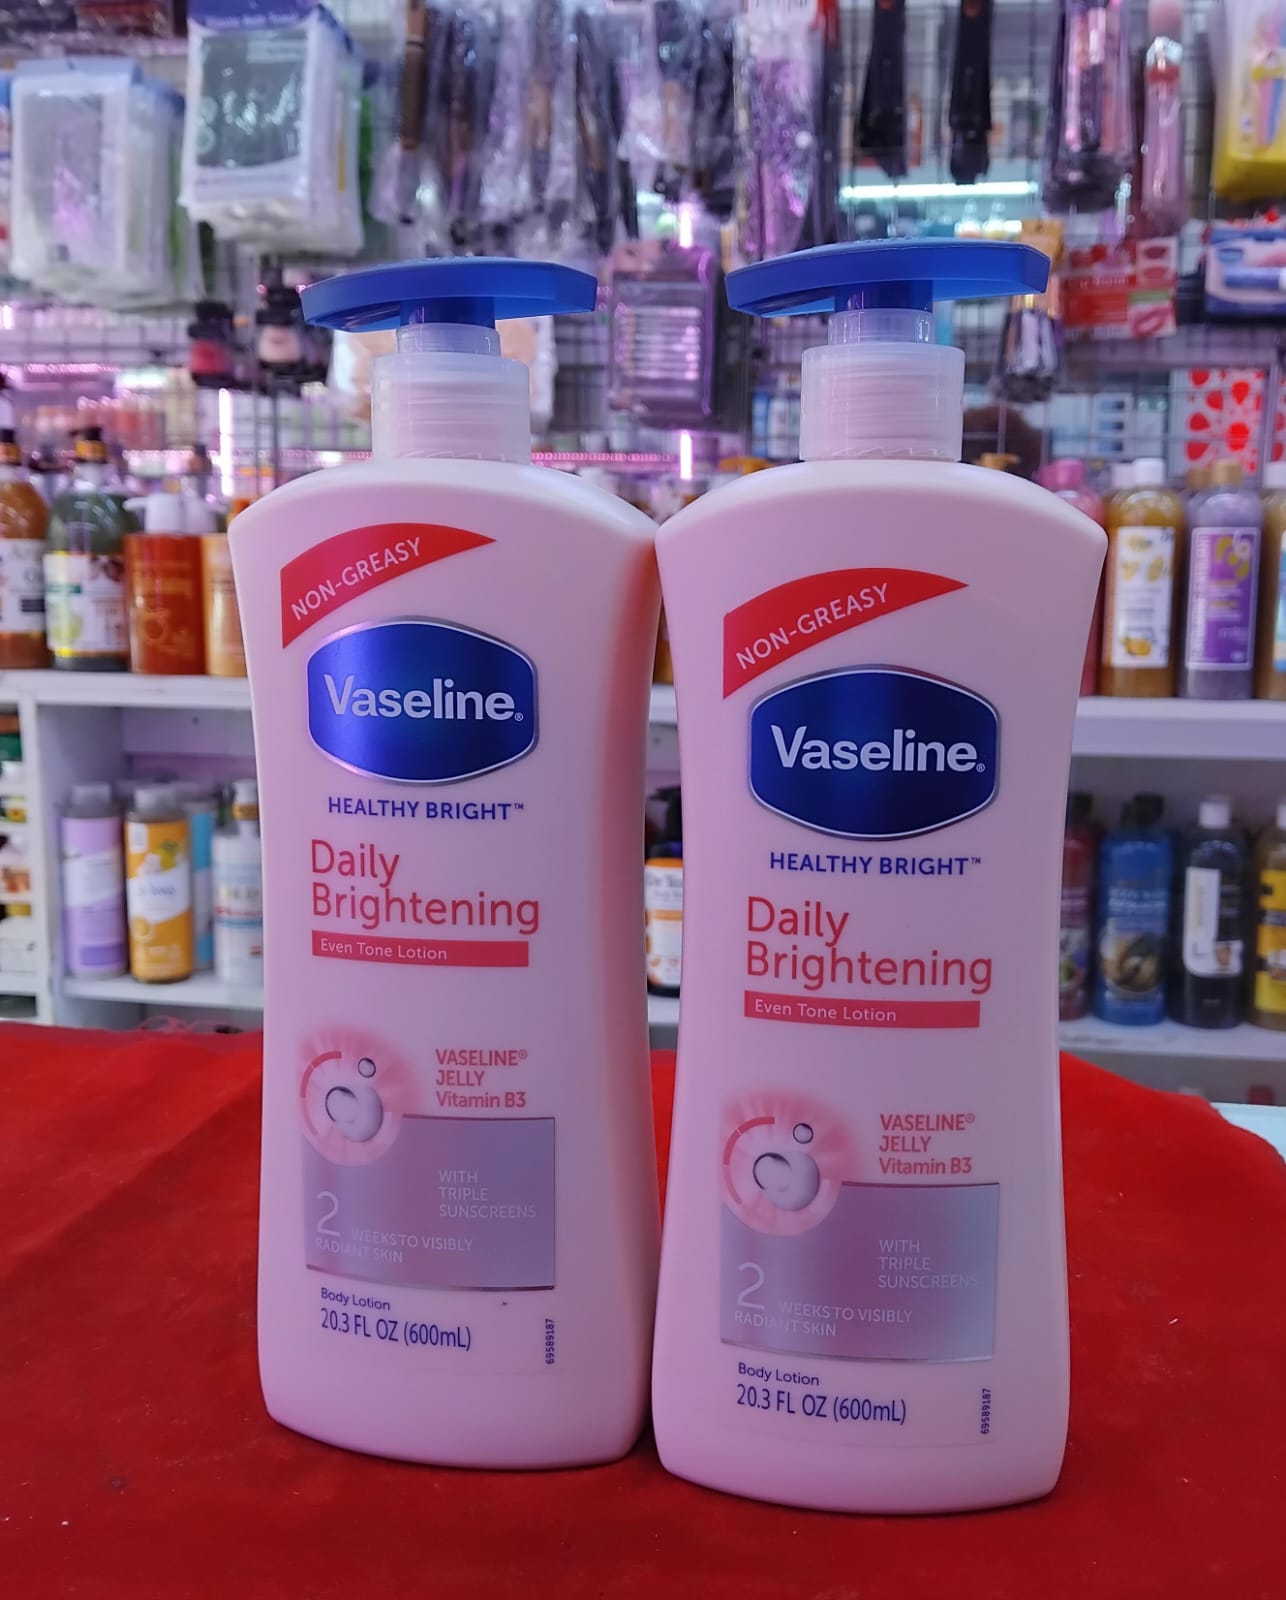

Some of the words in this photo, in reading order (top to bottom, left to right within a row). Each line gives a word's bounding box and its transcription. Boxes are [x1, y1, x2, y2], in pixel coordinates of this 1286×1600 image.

[290, 536, 421, 620] NON-GREASY
[736, 583, 889, 670] NON-GREASY
[328, 797, 420, 818] HEALTHY
[311, 839, 400, 888] Daily
[770, 852, 873, 874] HEALTHY
[312, 882, 539, 935] Brightening
[748, 896, 849, 948] Daily
[320, 938, 353, 955] Even
[357, 942, 393, 958] Tone
[398, 945, 448, 960] Lotion
[747, 940, 992, 995] Brightening
[755, 999, 792, 1016] Even
[797, 1003, 837, 1020] Tone
[843, 1007, 897, 1022] Lotion
[436, 1069, 486, 1087] JELLY
[436, 1090, 500, 1109] Vitamin
[504, 1091, 527, 1109] B3
[879, 1135, 932, 1152] JELLY
[438, 1169, 478, 1185] WITH
[879, 1157, 946, 1175] Vitamin
[950, 1157, 972, 1174] B3
[438, 1186, 489, 1202] TRIPLE
[316, 1190, 341, 1237] 2
[351, 1228, 397, 1247] WEEKS
[398, 1234, 419, 1248] TO
[421, 1235, 473, 1252] VISIBLY
[439, 1203, 536, 1219] SUNSCREENS
[315, 1236, 370, 1260] RADIANT
[372, 1247, 404, 1264] SKIN
[878, 1239, 920, 1253] WITH
[878, 1256, 932, 1271] TRIPLE
[736, 1261, 766, 1310] 2
[778, 1301, 831, 1319] WEEKS
[831, 1306, 855, 1321] TO
[857, 1308, 913, 1324] VISIBLY
[878, 1273, 978, 1289] SUNSCREENS
[320, 1287, 350, 1307] Body
[352, 1294, 391, 1311] Lotion
[320, 1307, 351, 1334] 20.3
[353, 1314, 372, 1338] FL
[375, 1318, 400, 1342] OZ
[403, 1321, 472, 1352] (600mL)
[734, 1309, 800, 1333] RADIANT
[801, 1320, 837, 1337] SKIN
[544, 1317, 556, 1365] 69589187
[737, 1361, 773, 1382] Body
[775, 1368, 820, 1387] Lotion
[736, 1383, 771, 1411] 20.3
[776, 1390, 796, 1414] FL
[801, 1394, 828, 1418] OZ
[832, 1396, 907, 1426] (600mL)
[980, 1387, 993, 1435] 69589187
